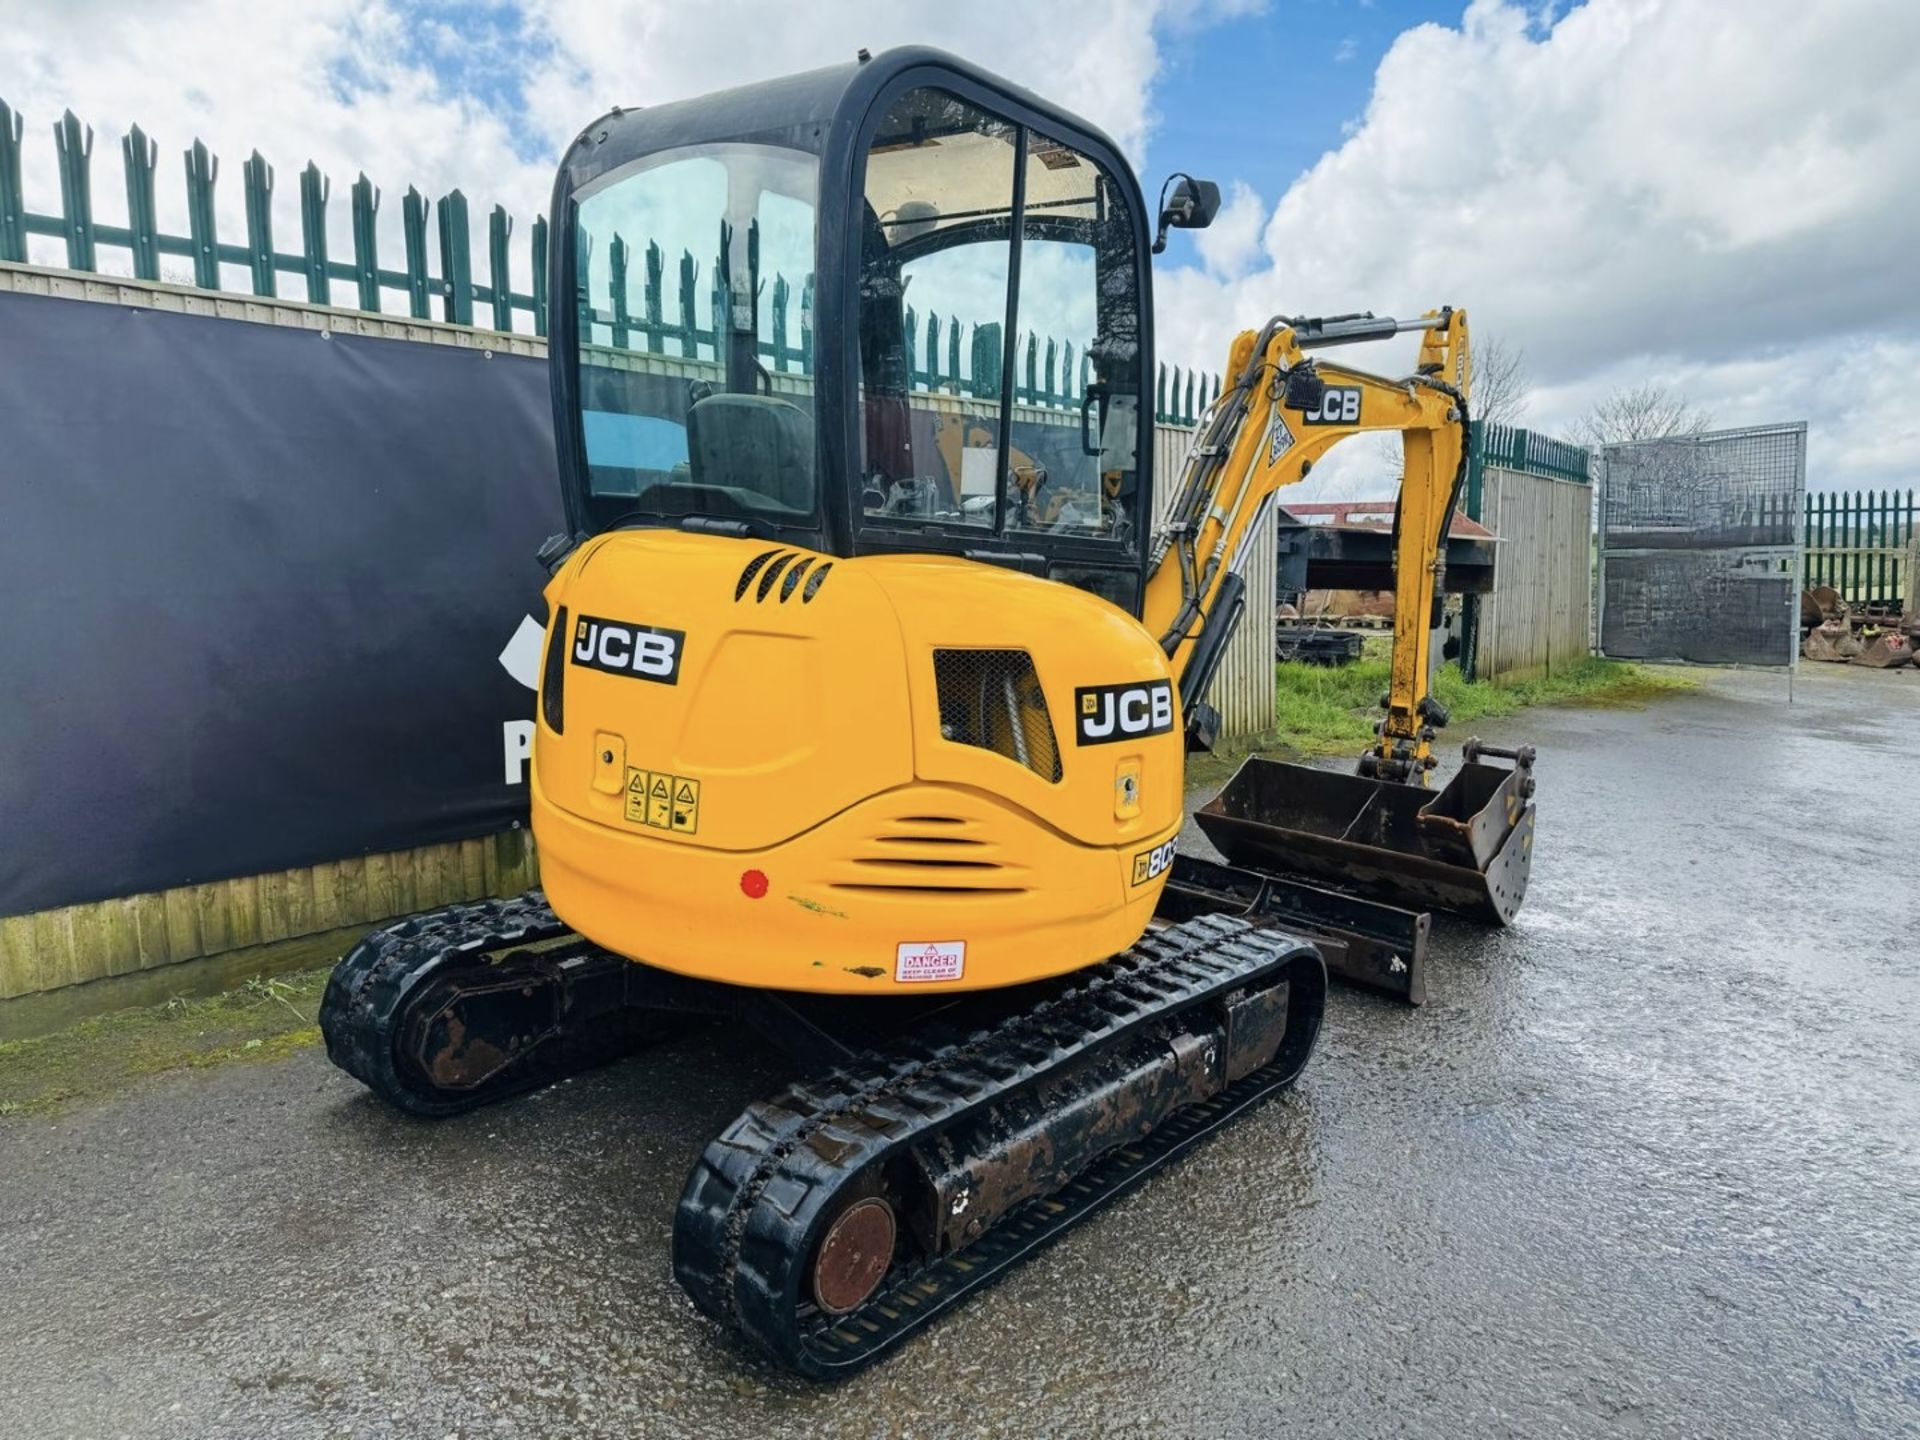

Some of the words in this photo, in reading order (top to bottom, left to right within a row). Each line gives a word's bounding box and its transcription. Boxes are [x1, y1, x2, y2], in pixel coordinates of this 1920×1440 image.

[576, 624, 675, 676] JCB
[1083, 686, 1172, 737] JCB
[905, 955, 957, 967] DANGER
